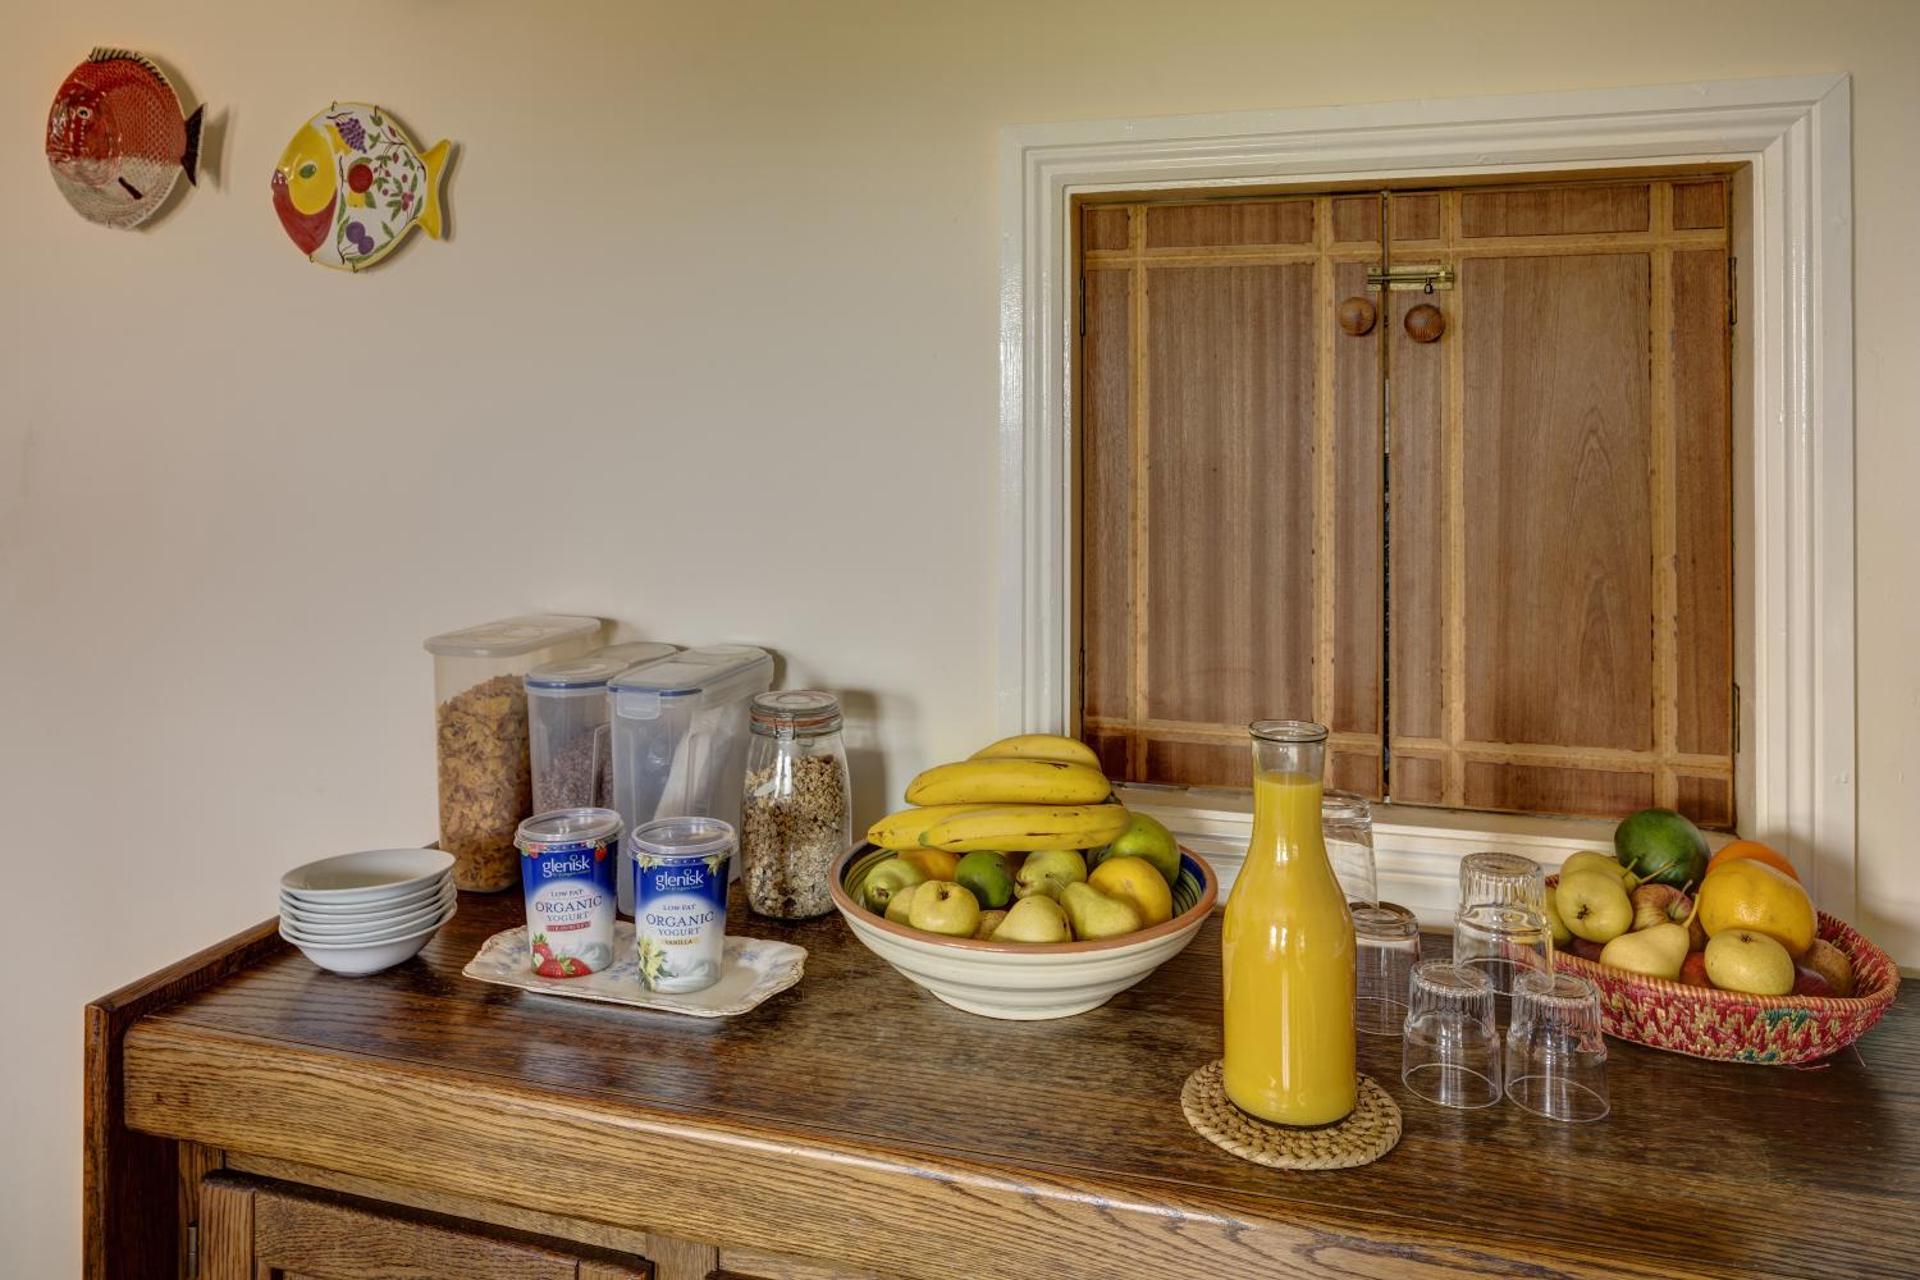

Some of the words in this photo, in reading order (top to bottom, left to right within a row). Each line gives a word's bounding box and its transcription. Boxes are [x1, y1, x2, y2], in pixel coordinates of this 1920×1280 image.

[542, 855, 590, 878] glenisk
[655, 869, 704, 891] glenisk
[535, 896, 602, 913] ORGANIC
[547, 911, 589, 921] YOGURT
[646, 911, 714, 928] ORGANIC
[658, 927, 700, 937] YOGURT
